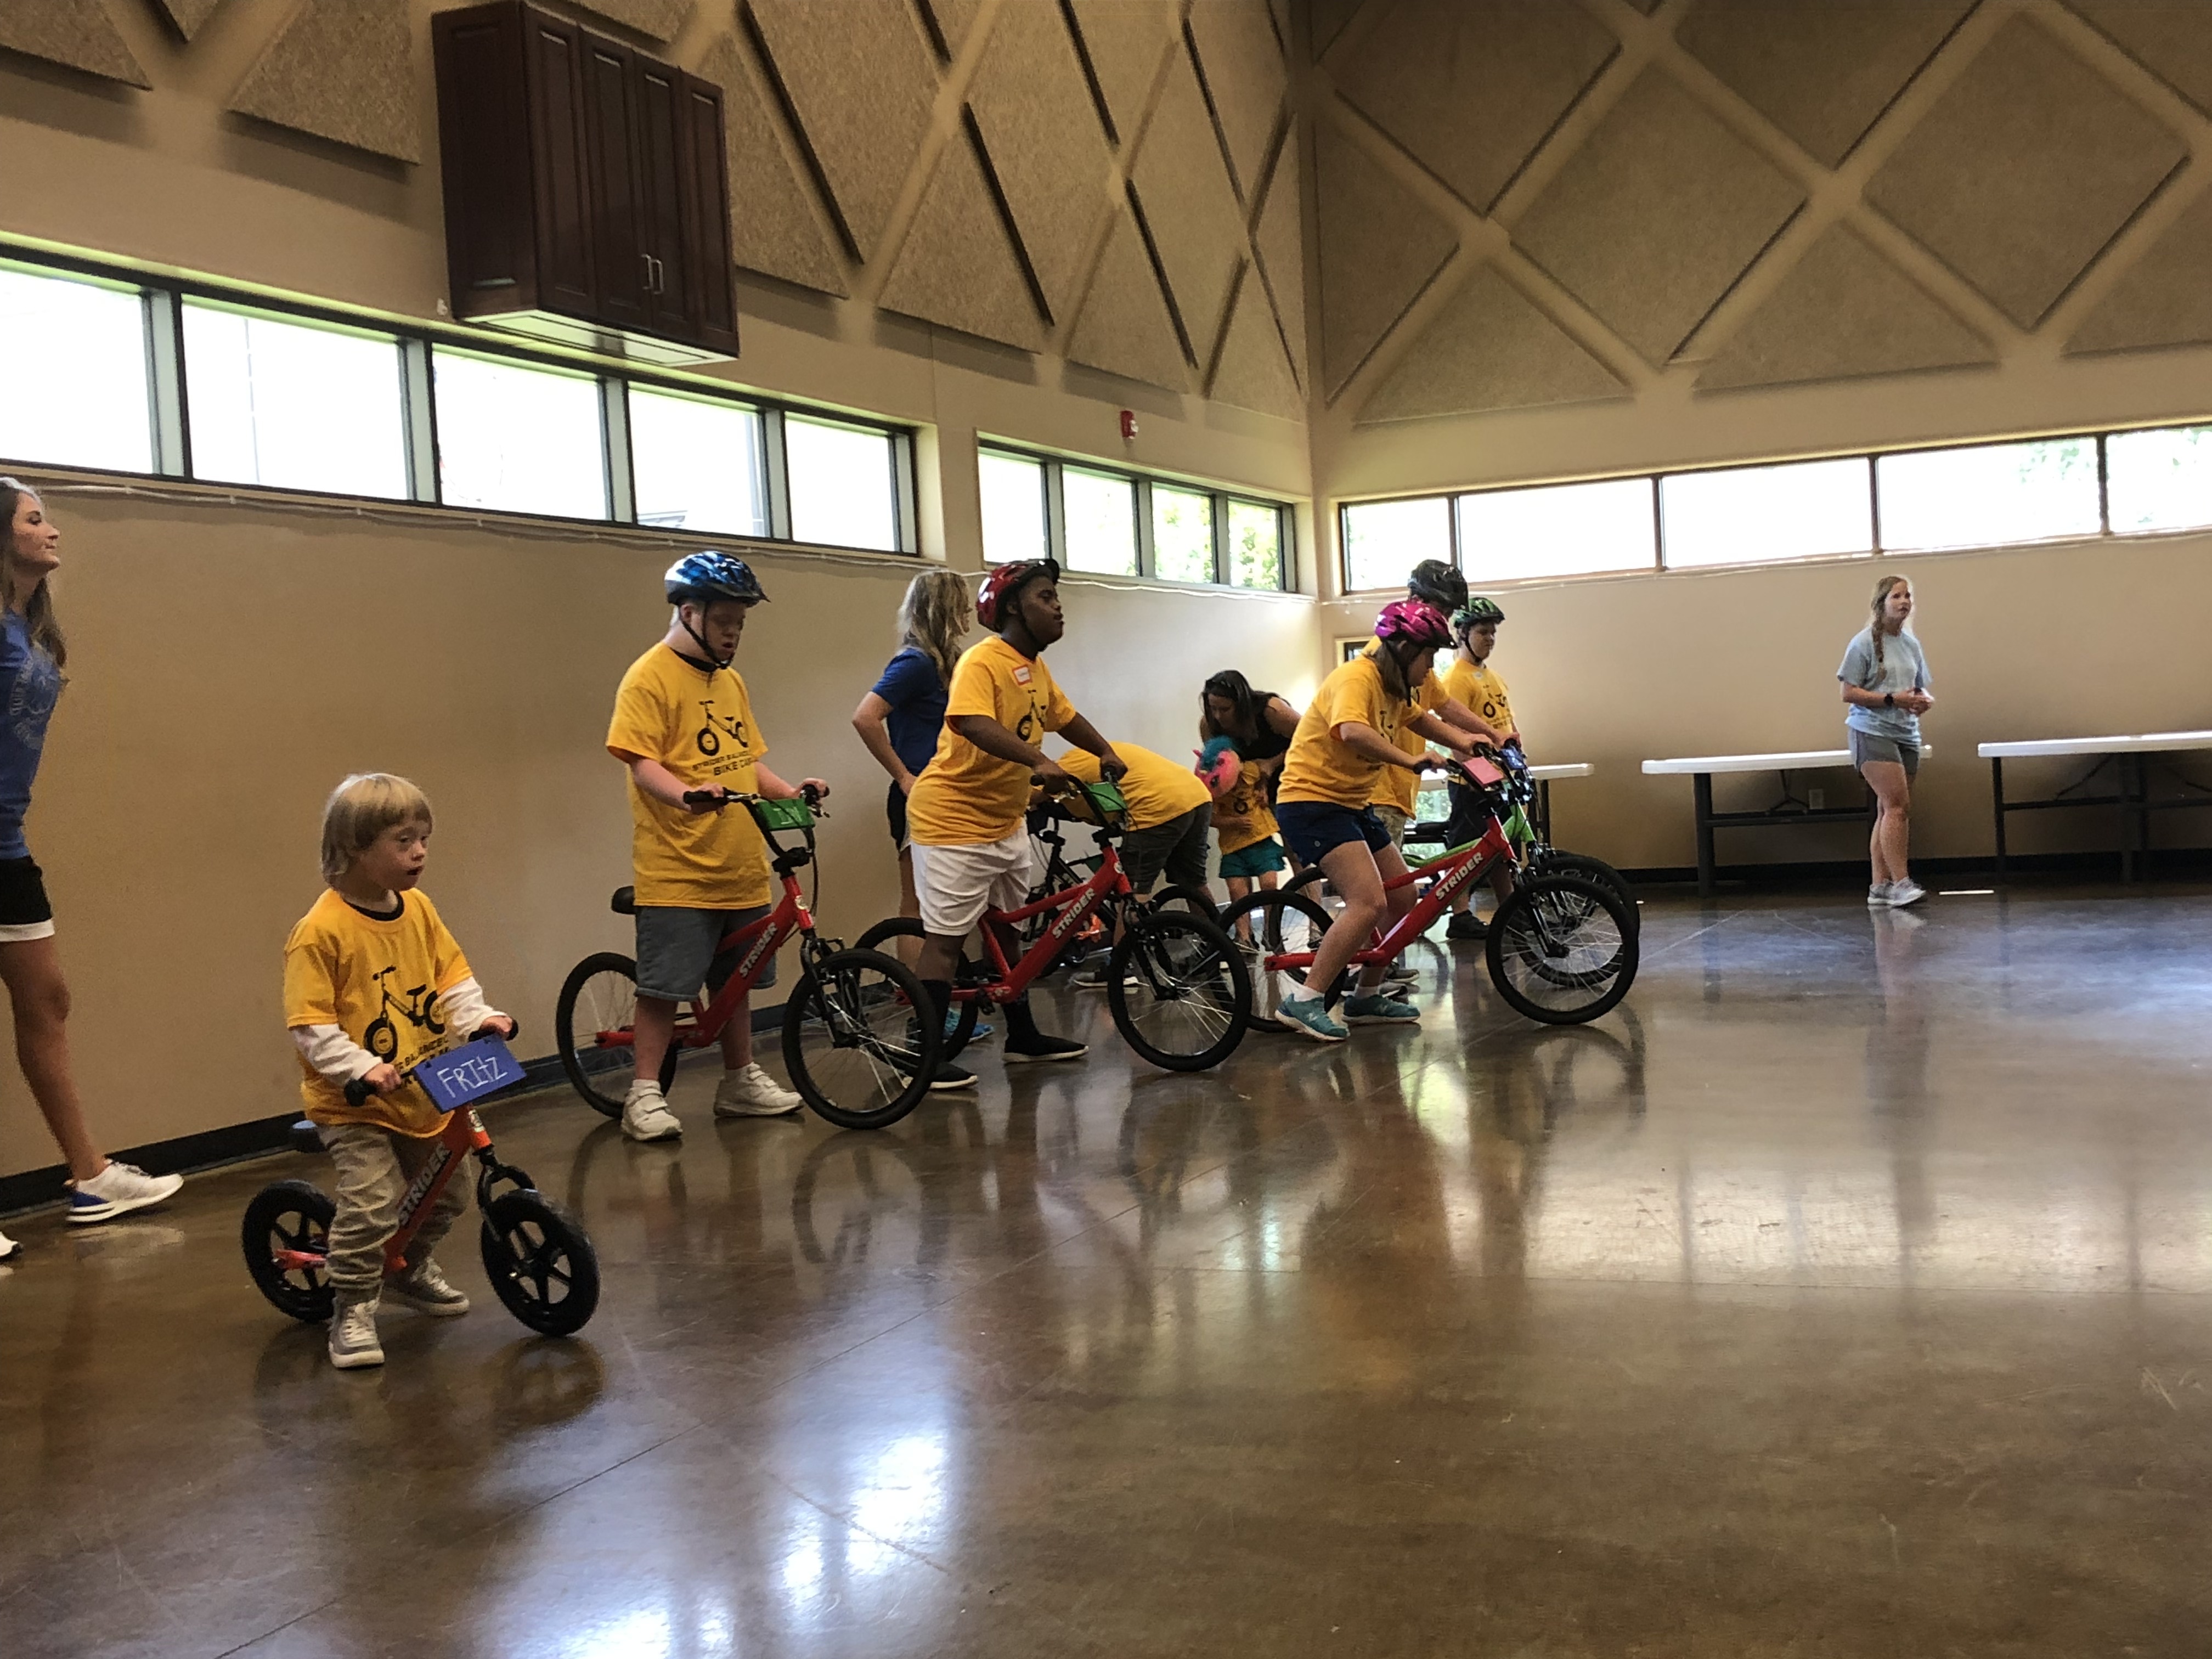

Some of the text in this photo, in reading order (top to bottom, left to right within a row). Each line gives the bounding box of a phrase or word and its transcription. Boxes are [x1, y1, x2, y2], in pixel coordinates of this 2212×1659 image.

[714, 761, 738, 776] BIKE
[1436, 852, 1483, 900] STRIDER
[1052, 888, 1096, 939] STRIDER
[740, 922, 777, 978] STRIDER
[398, 1141, 451, 1226] STRIDER
